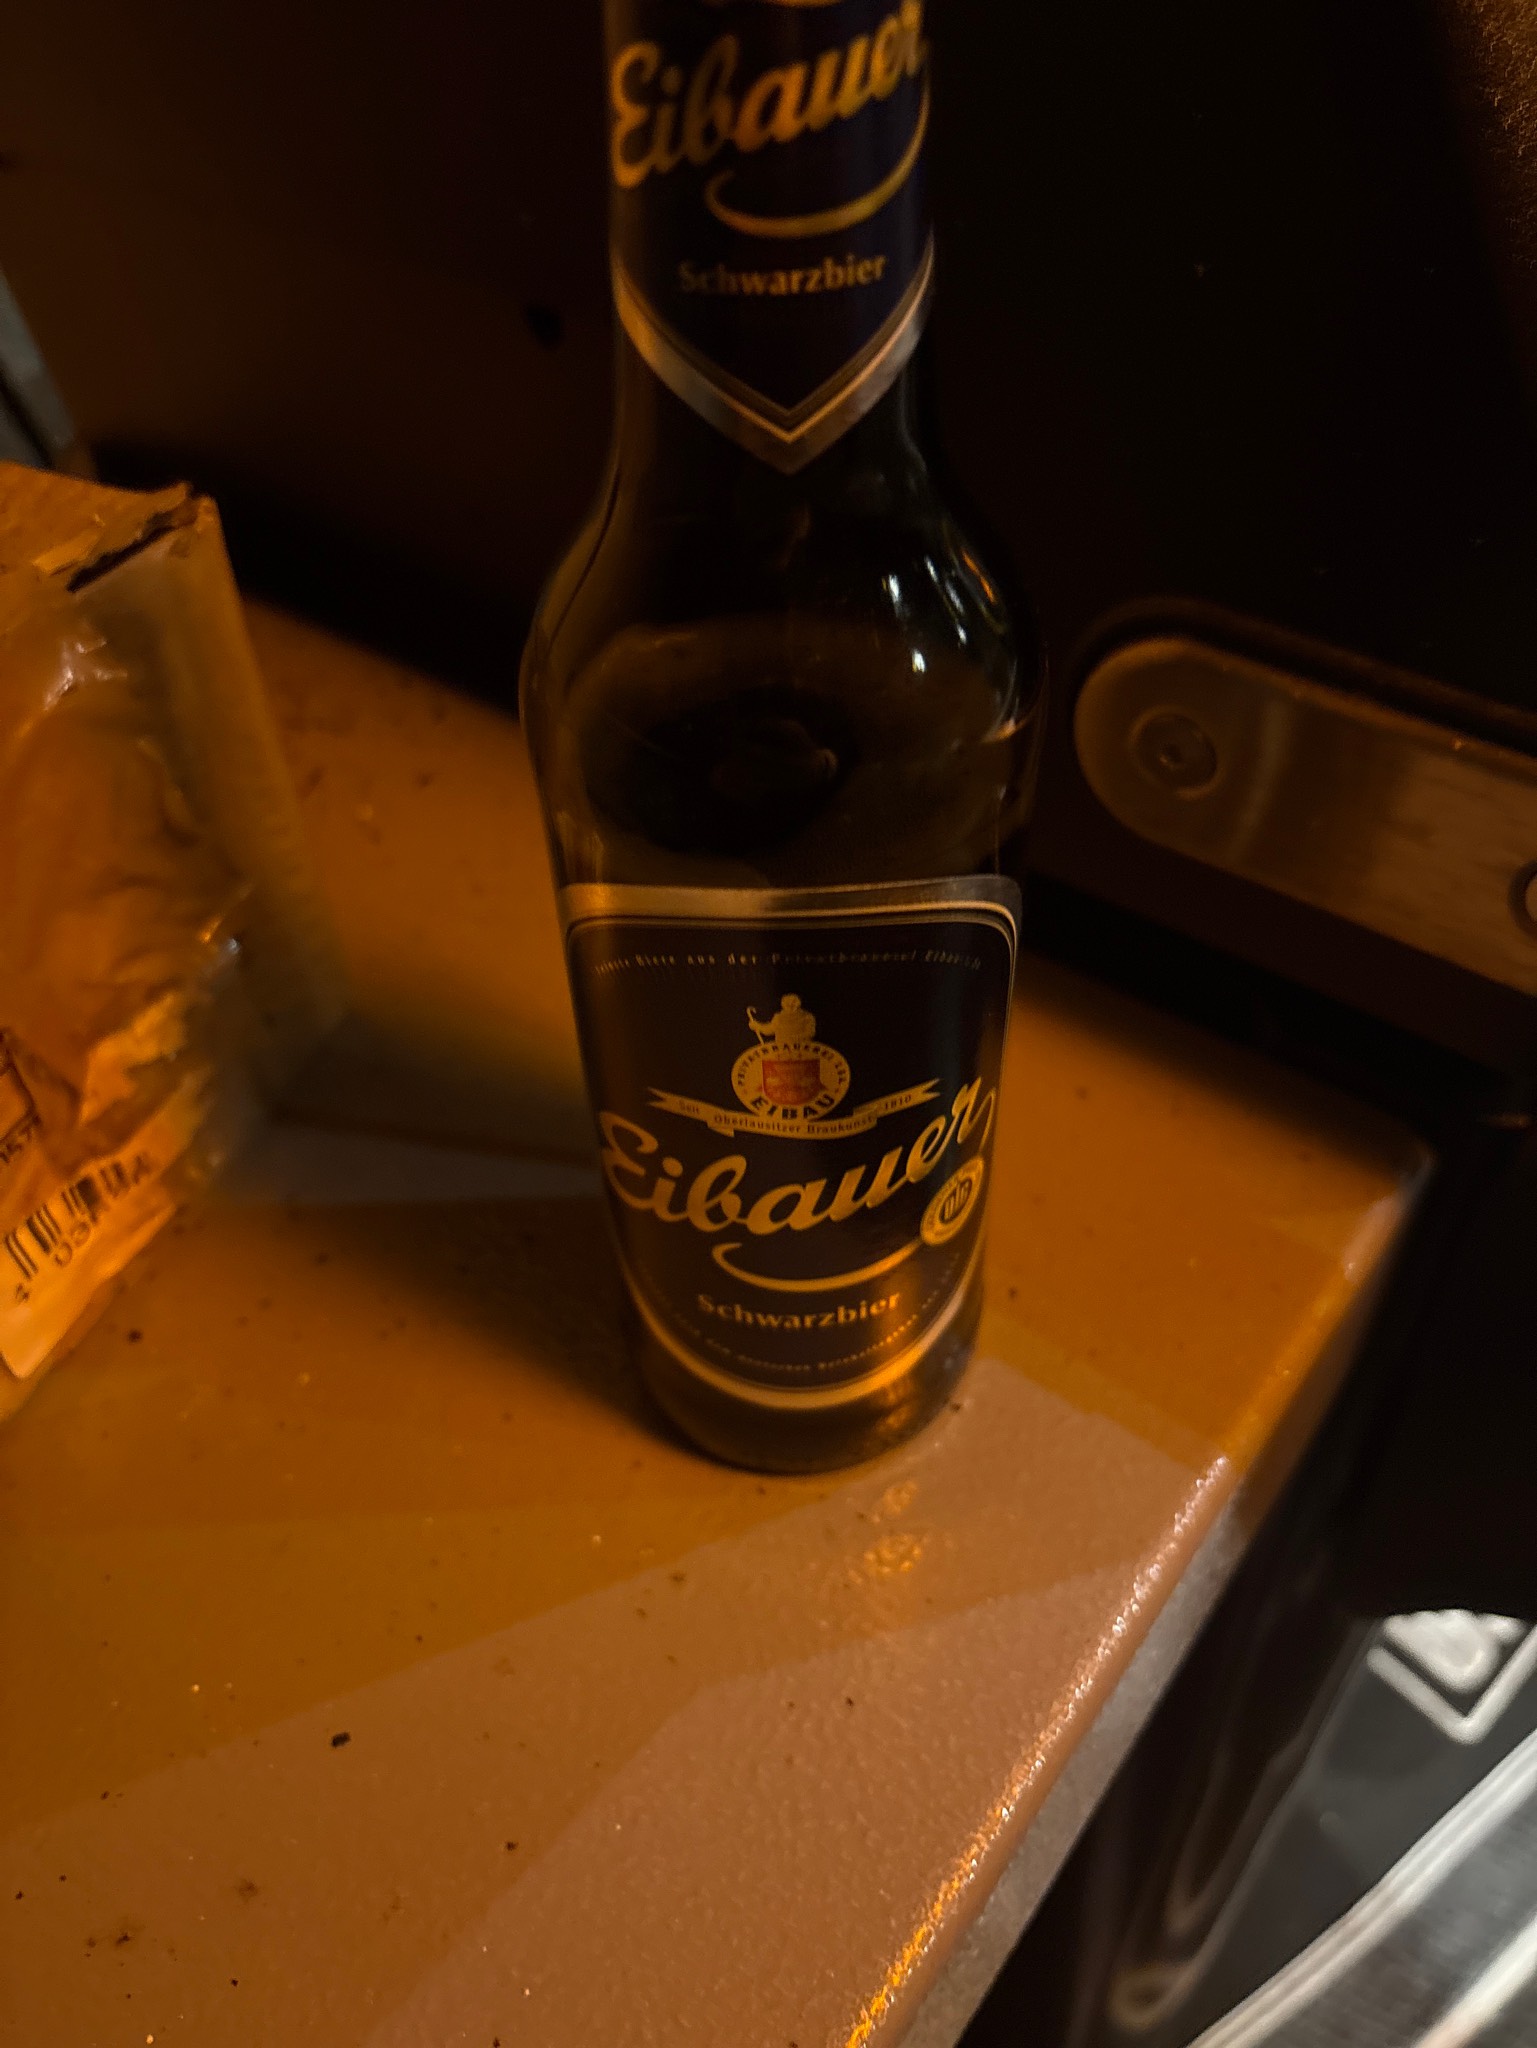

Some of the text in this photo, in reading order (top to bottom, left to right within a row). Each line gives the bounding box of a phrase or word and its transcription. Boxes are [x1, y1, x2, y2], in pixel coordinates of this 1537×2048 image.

[609, 2, 930, 189] Eibauer
[677, 251, 888, 298] Schwarzbier
[750, 1092, 836, 1121] EIBAU
[598, 1076, 998, 1238] Eibauer
[697, 1290, 902, 1333] Schwarzbier
